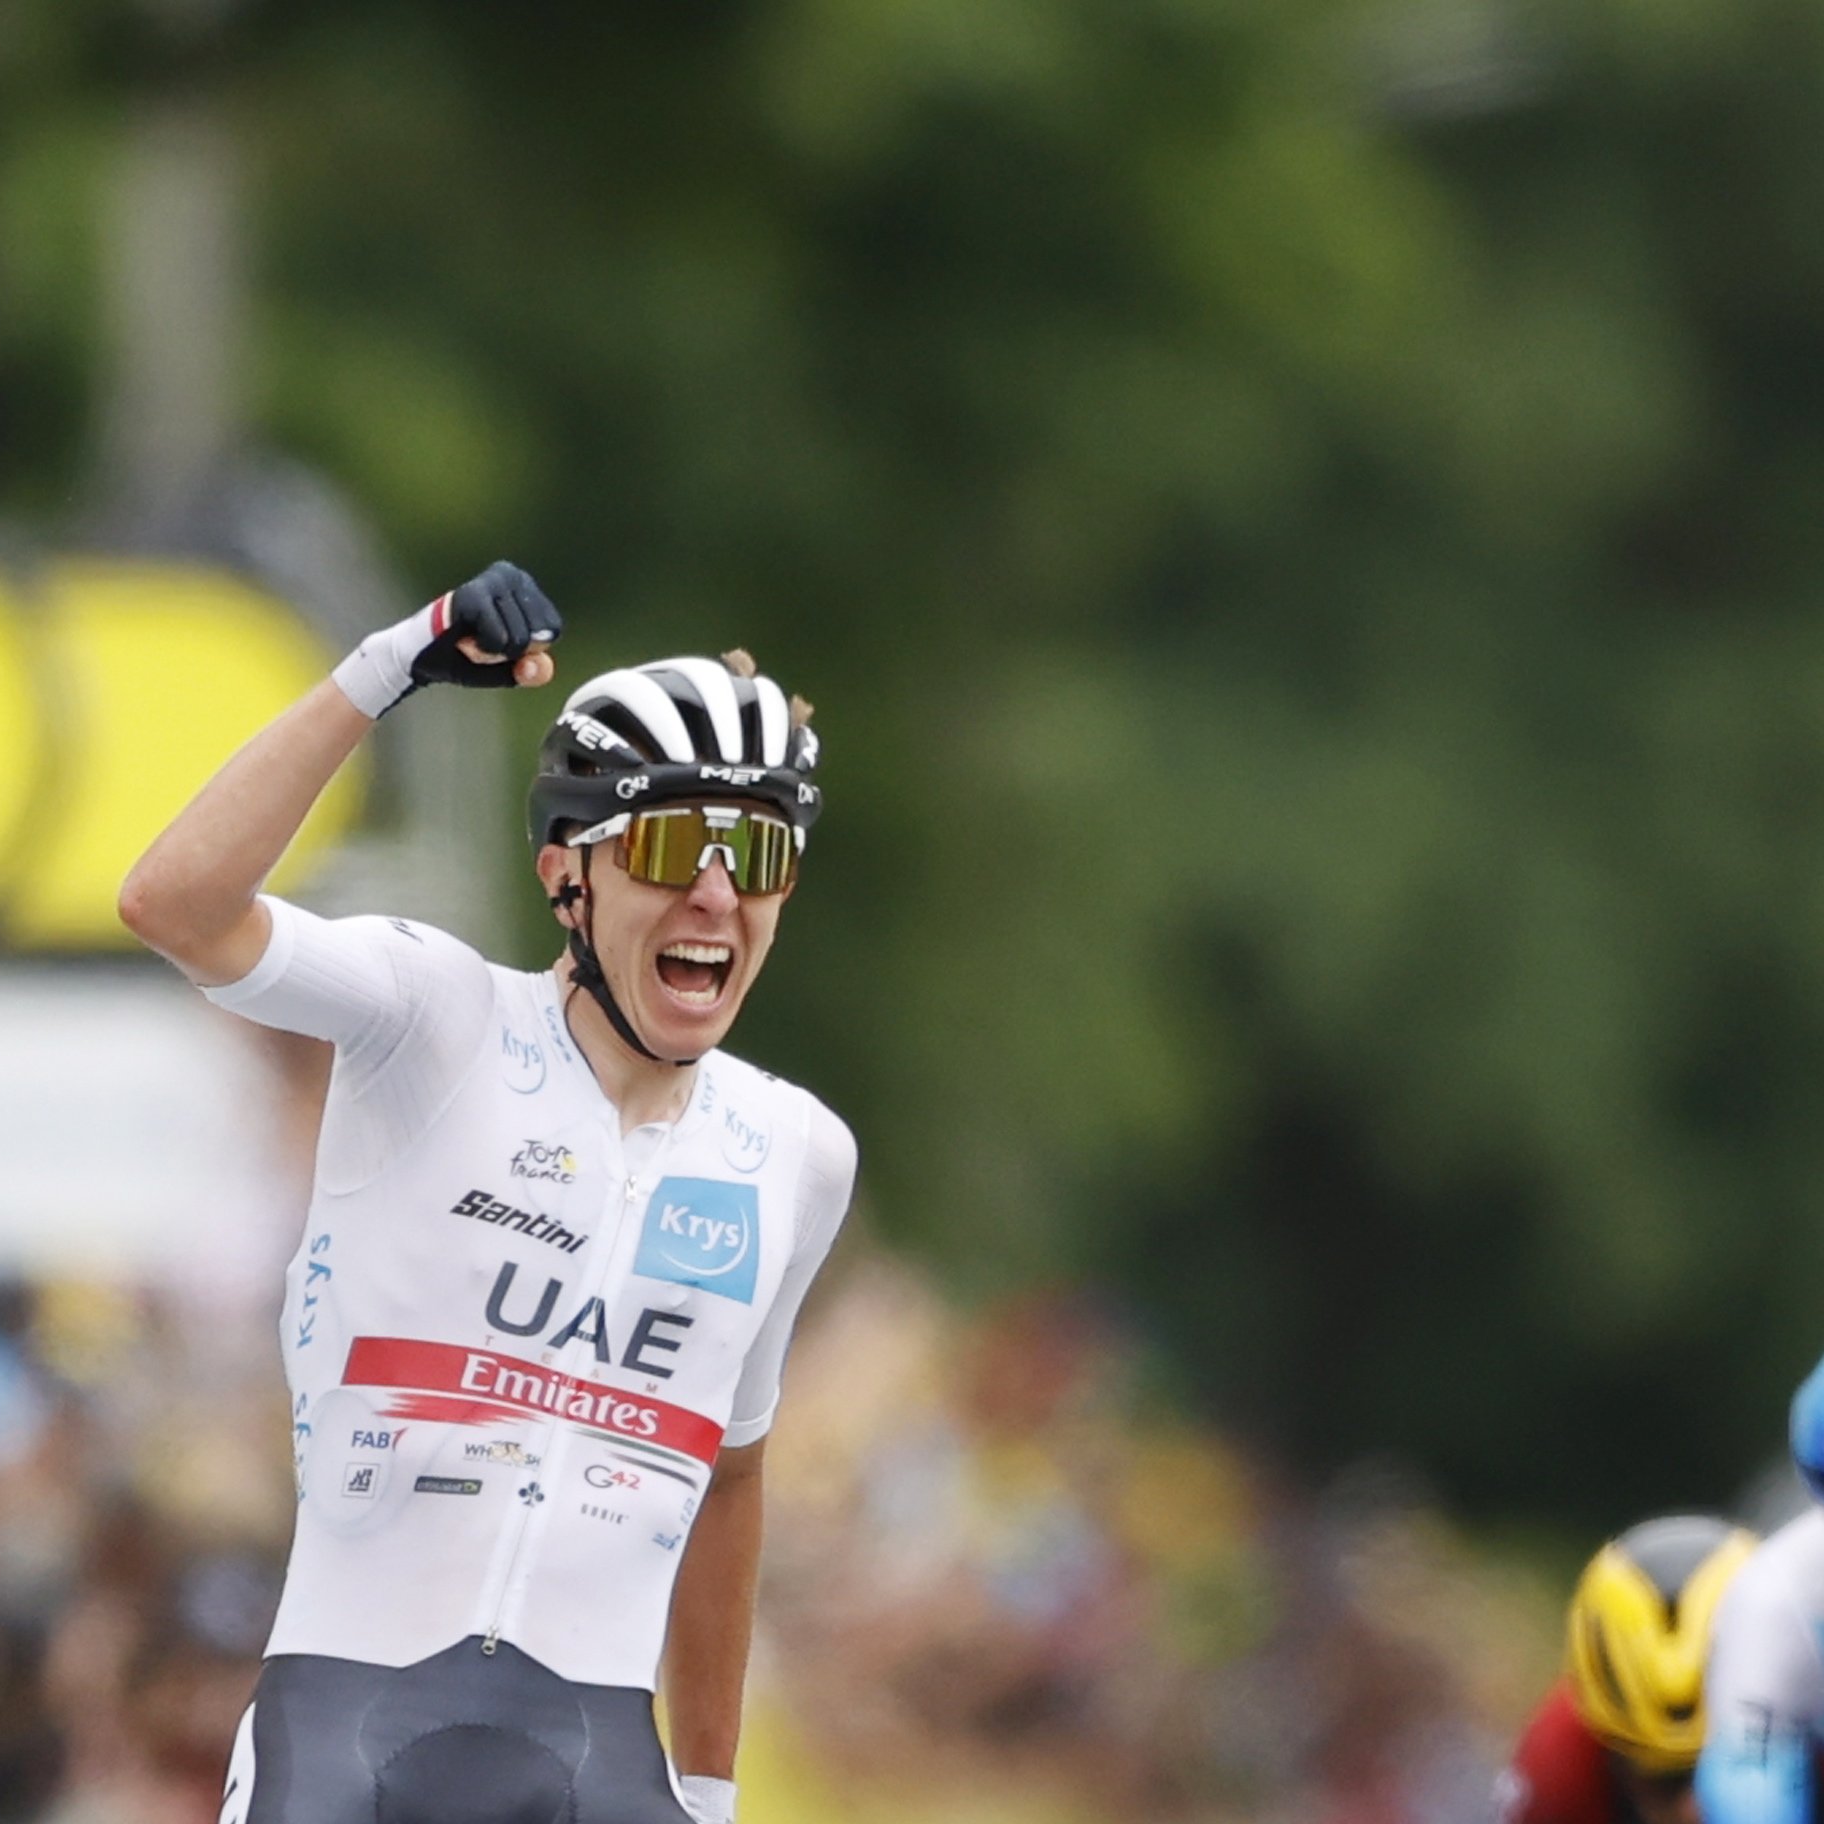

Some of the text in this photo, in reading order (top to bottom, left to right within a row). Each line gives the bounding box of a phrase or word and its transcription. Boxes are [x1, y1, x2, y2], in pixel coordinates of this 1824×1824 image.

[557, 711, 629, 750] MET
[616, 775, 649, 799] G42
[700, 766, 767, 785] MET
[502, 1025, 541, 1069] Krys
[724, 1106, 766, 1153] Krys
[450, 1188, 589, 1254] Santini
[660, 1203, 740, 1251] Krys
[296, 1233, 332, 1349] Krys
[485, 1260, 695, 1380] UAE
[460, 1352, 659, 1437] Emirates
[584, 1463, 641, 1491] G42
